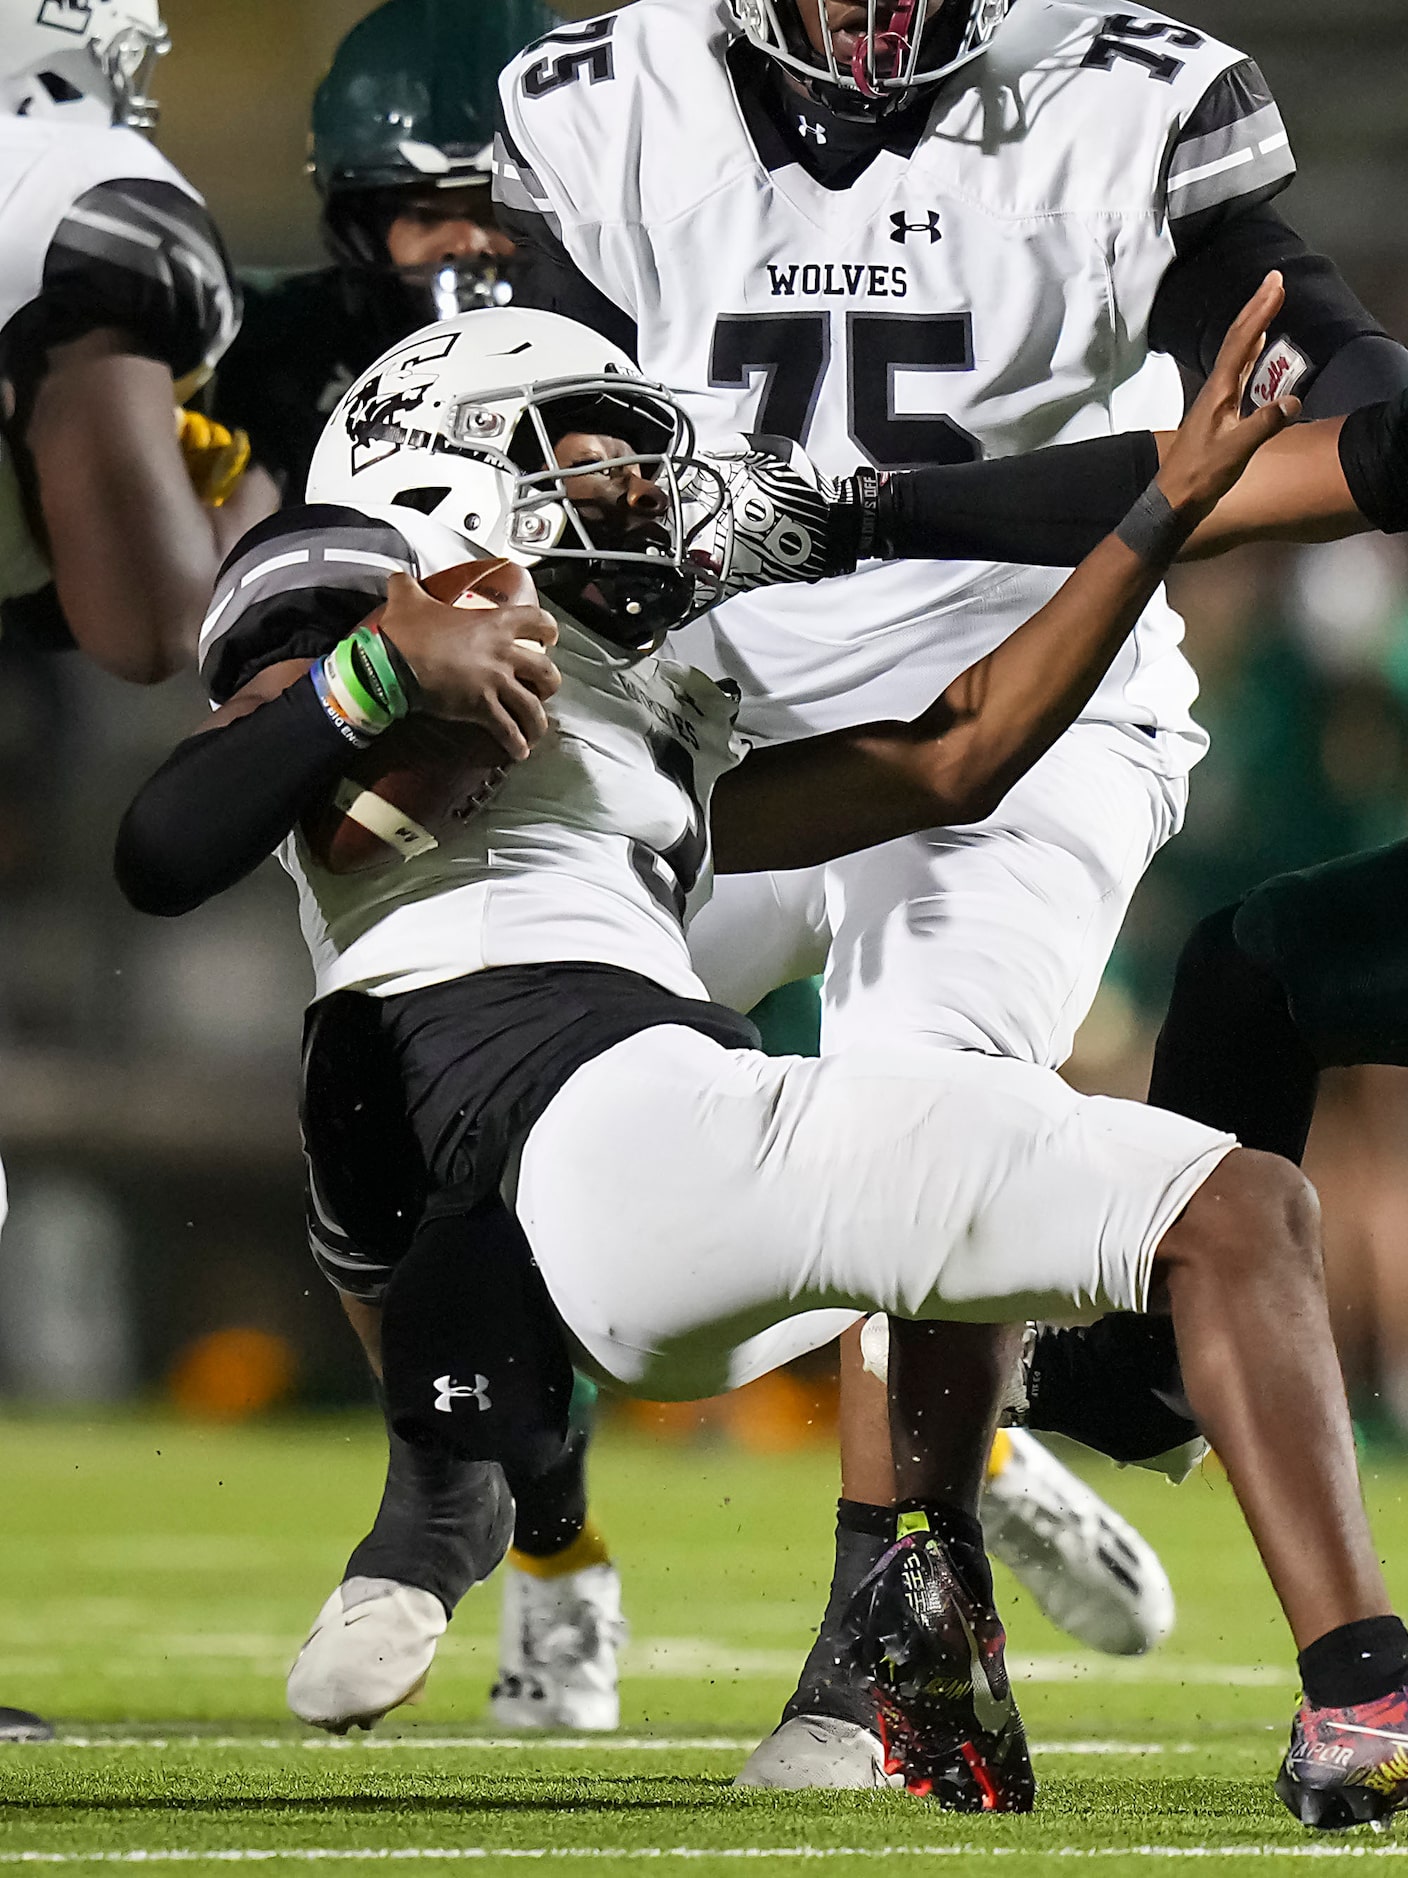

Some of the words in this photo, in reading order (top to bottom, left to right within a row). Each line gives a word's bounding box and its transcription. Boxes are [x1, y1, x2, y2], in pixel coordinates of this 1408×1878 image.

[520, 15, 618, 100] 75
[1079, 14, 1207, 85] 75
[767, 264, 907, 297] WOLVES
[707, 310, 985, 473] 75
[864, 476, 877, 498] OFF
